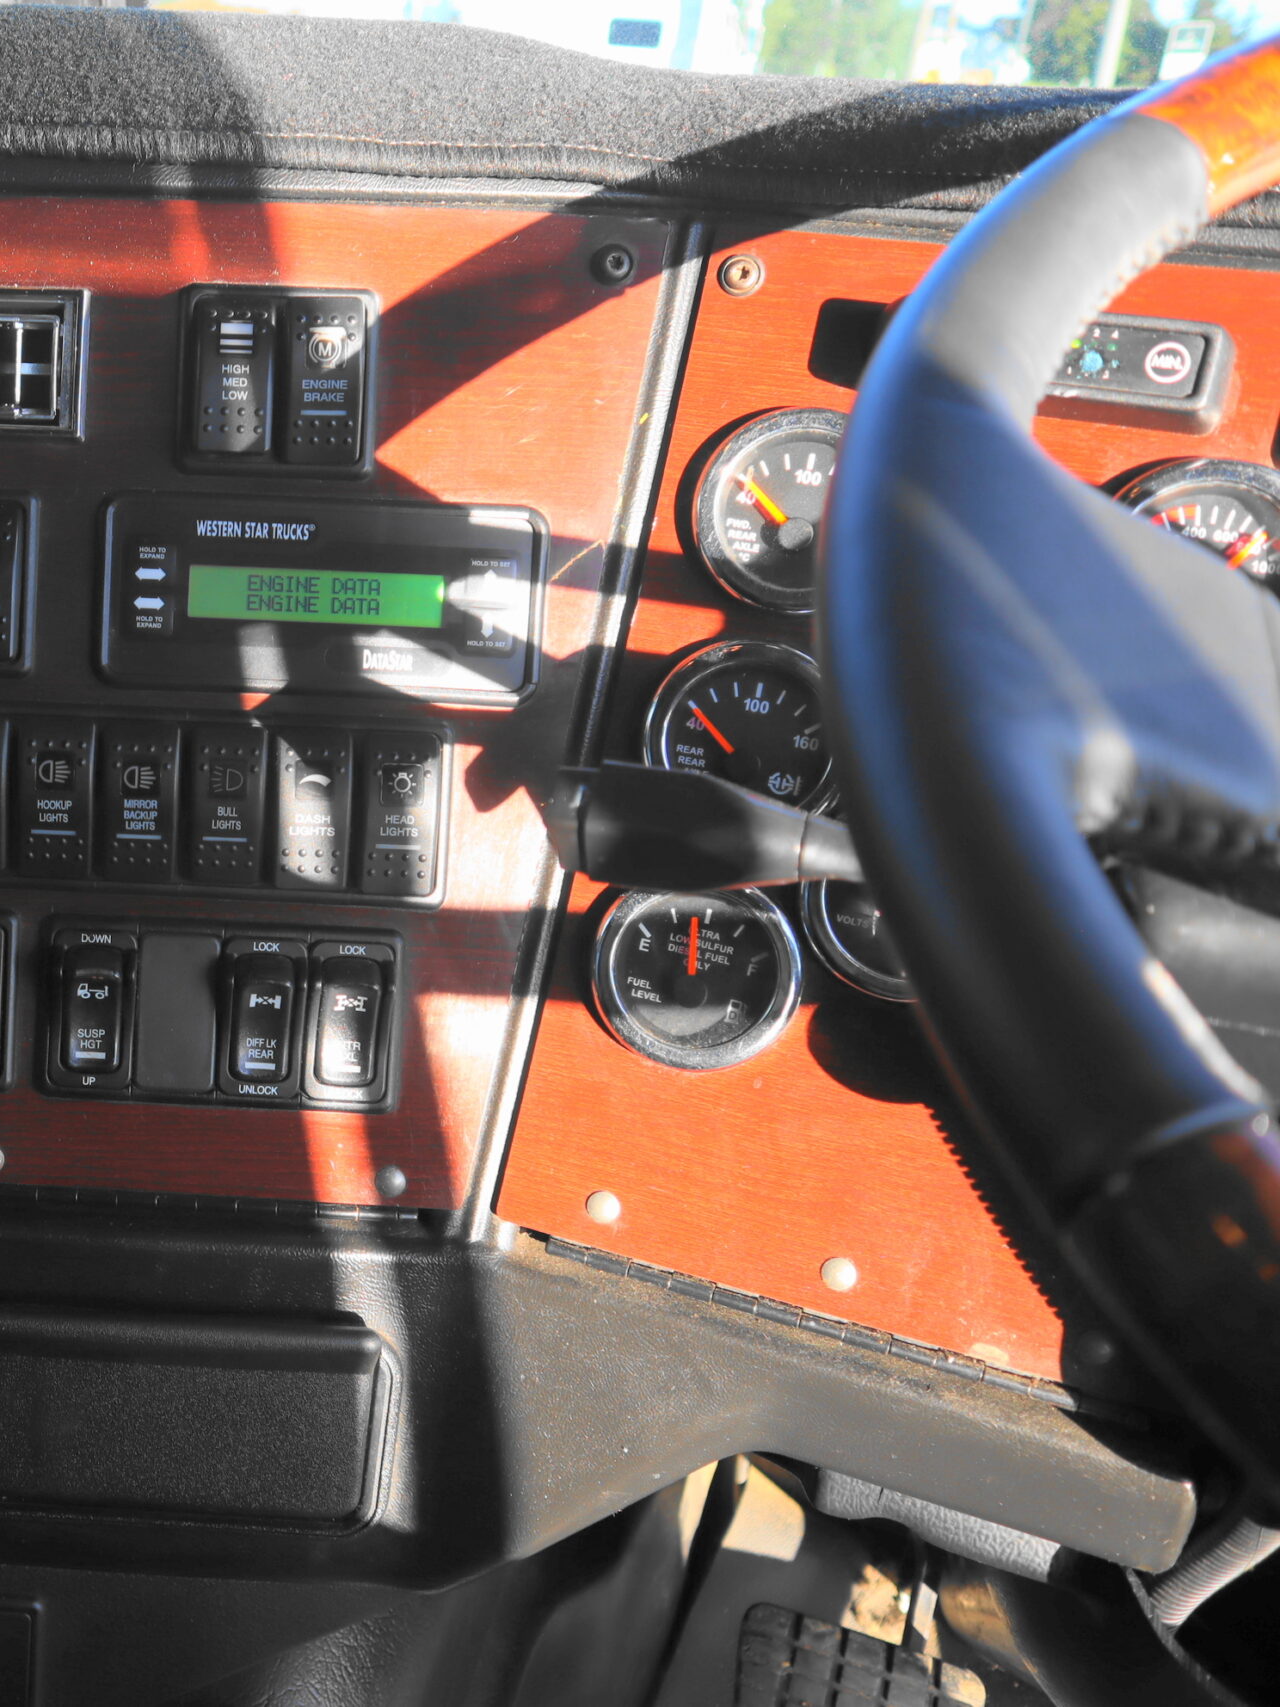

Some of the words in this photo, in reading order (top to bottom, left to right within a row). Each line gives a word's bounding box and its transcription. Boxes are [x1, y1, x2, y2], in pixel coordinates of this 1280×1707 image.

[222, 364, 249, 375] HIGH
[223, 378, 248, 387] MED
[303, 380, 348, 390] ENGINE
[222, 390, 248, 400] LOW
[304, 393, 345, 402] BRAKE
[794, 470, 822, 486] 100
[196, 520, 242, 538] WESTERN
[245, 522, 270, 539] STAR
[728, 529, 757, 541] REAR
[732, 541, 760, 553] AXLE
[247, 574, 320, 594] ENGINE
[331, 577, 381, 596] DATA
[246, 595, 319, 613] ENGINE
[330, 597, 380, 615] DATA
[744, 698, 770, 714] 100
[793, 734, 819, 751] 160
[676, 744, 704, 756] REAR
[678, 755, 706, 767] REAR
[37, 799, 72, 811] HOOKUP
[123, 799, 158, 811] MIRROR
[39, 812, 68, 824] LIGHTS
[123, 810, 158, 822] BACKUP
[217, 807, 238, 818] BULL
[125, 820, 156, 832] LIGHTS
[211, 819, 241, 831] LIGHTS
[294, 813, 331, 827] DASH
[385, 815, 415, 827] HEAD
[289, 826, 335, 838] LIGHTS
[380, 827, 418, 838] LIGHTS
[836, 914, 870, 928] VOLTS
[81, 934, 112, 944] DOWN
[639, 938, 651, 952] E
[253, 942, 280, 953] LOCK
[339, 945, 366, 956] LOCK
[696, 940, 734, 955] SULFUR
[705, 952, 730, 965] FUEL
[746, 963, 758, 976] F
[627, 976, 652, 990] FUEL
[631, 988, 662, 1003] LEVEL
[77, 1028, 106, 1039] SUSP
[80, 1039, 102, 1050] HGT
[246, 1038, 265, 1049] DIFF
[267, 1038, 277, 1049] LK
[248, 1048, 274, 1060] REAR
[82, 1077, 96, 1086] UP
[238, 1084, 278, 1096] UNLOCK
